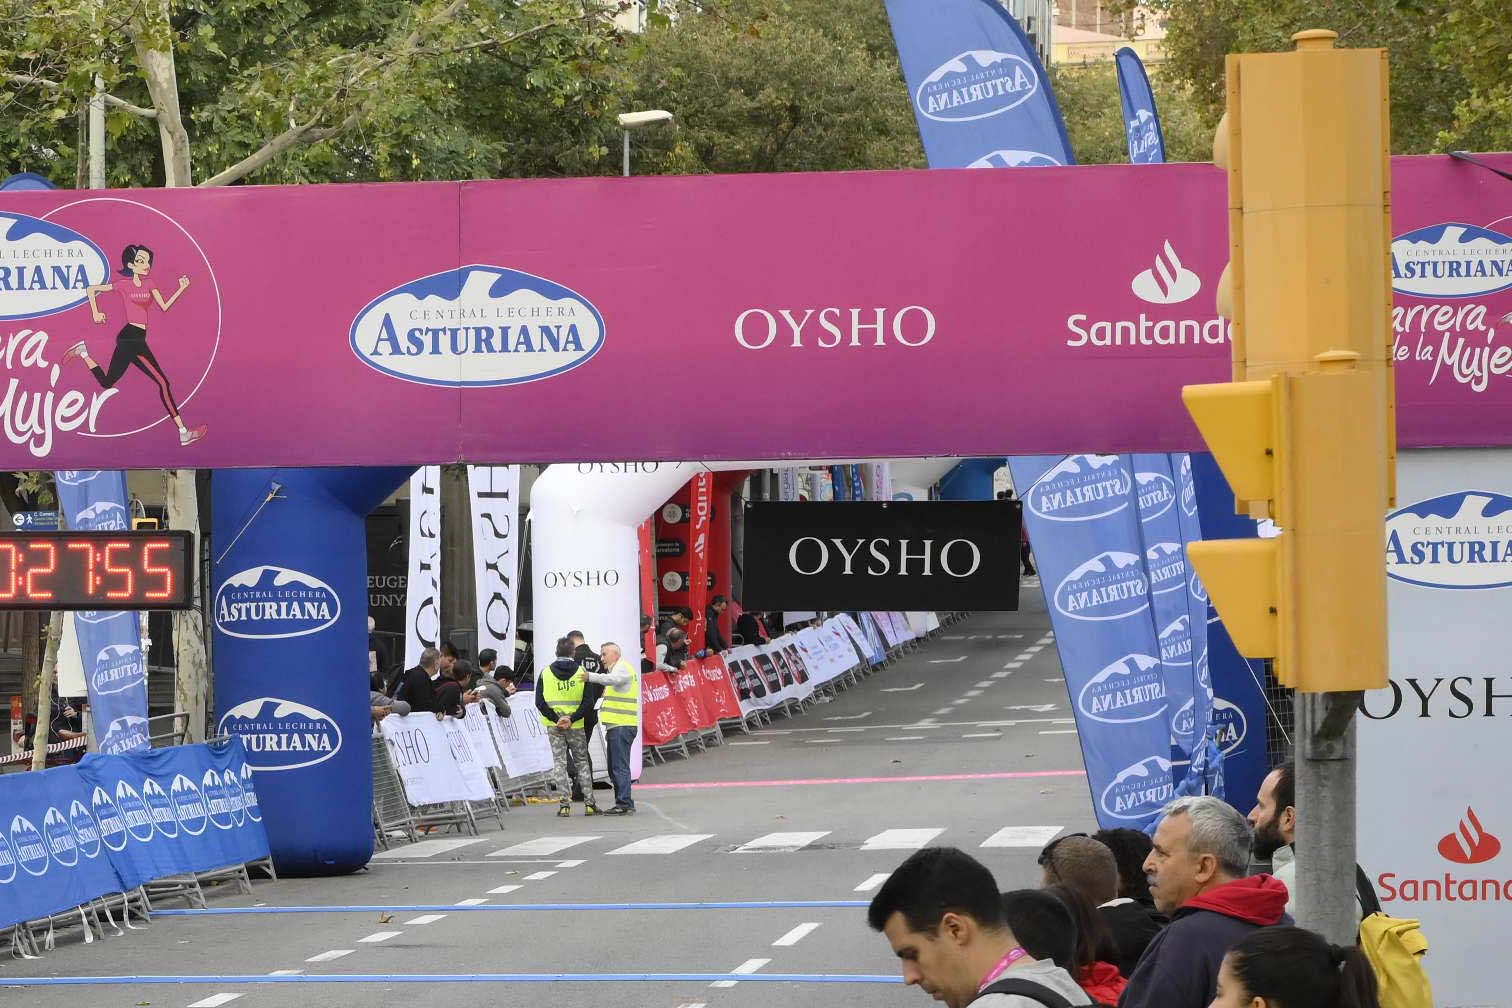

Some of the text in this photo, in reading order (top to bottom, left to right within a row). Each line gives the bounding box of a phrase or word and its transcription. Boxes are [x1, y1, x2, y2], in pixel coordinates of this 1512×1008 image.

[12, 248, 85, 259] LECHERA
[409, 306, 577, 321] CENTRAL LECHERA
[1392, 303, 1487, 333] arrera
[370, 312, 586, 358] ASTURIANA
[734, 306, 936, 350] OYSHO
[1066, 313, 1233, 347] Santand
[1416, 334, 1433, 360] la
[1413, 527, 1481, 535] CENTRAL
[788, 536, 981, 577] OYSHO
[543, 569, 620, 588] OYSHO
[232, 590, 326, 599] CENTRAL LECHERA
[219, 595, 331, 623] ASTURIANA
[233, 722, 327, 731] CENTRAL LECHERA
[240, 732, 332, 752] TURIANA
